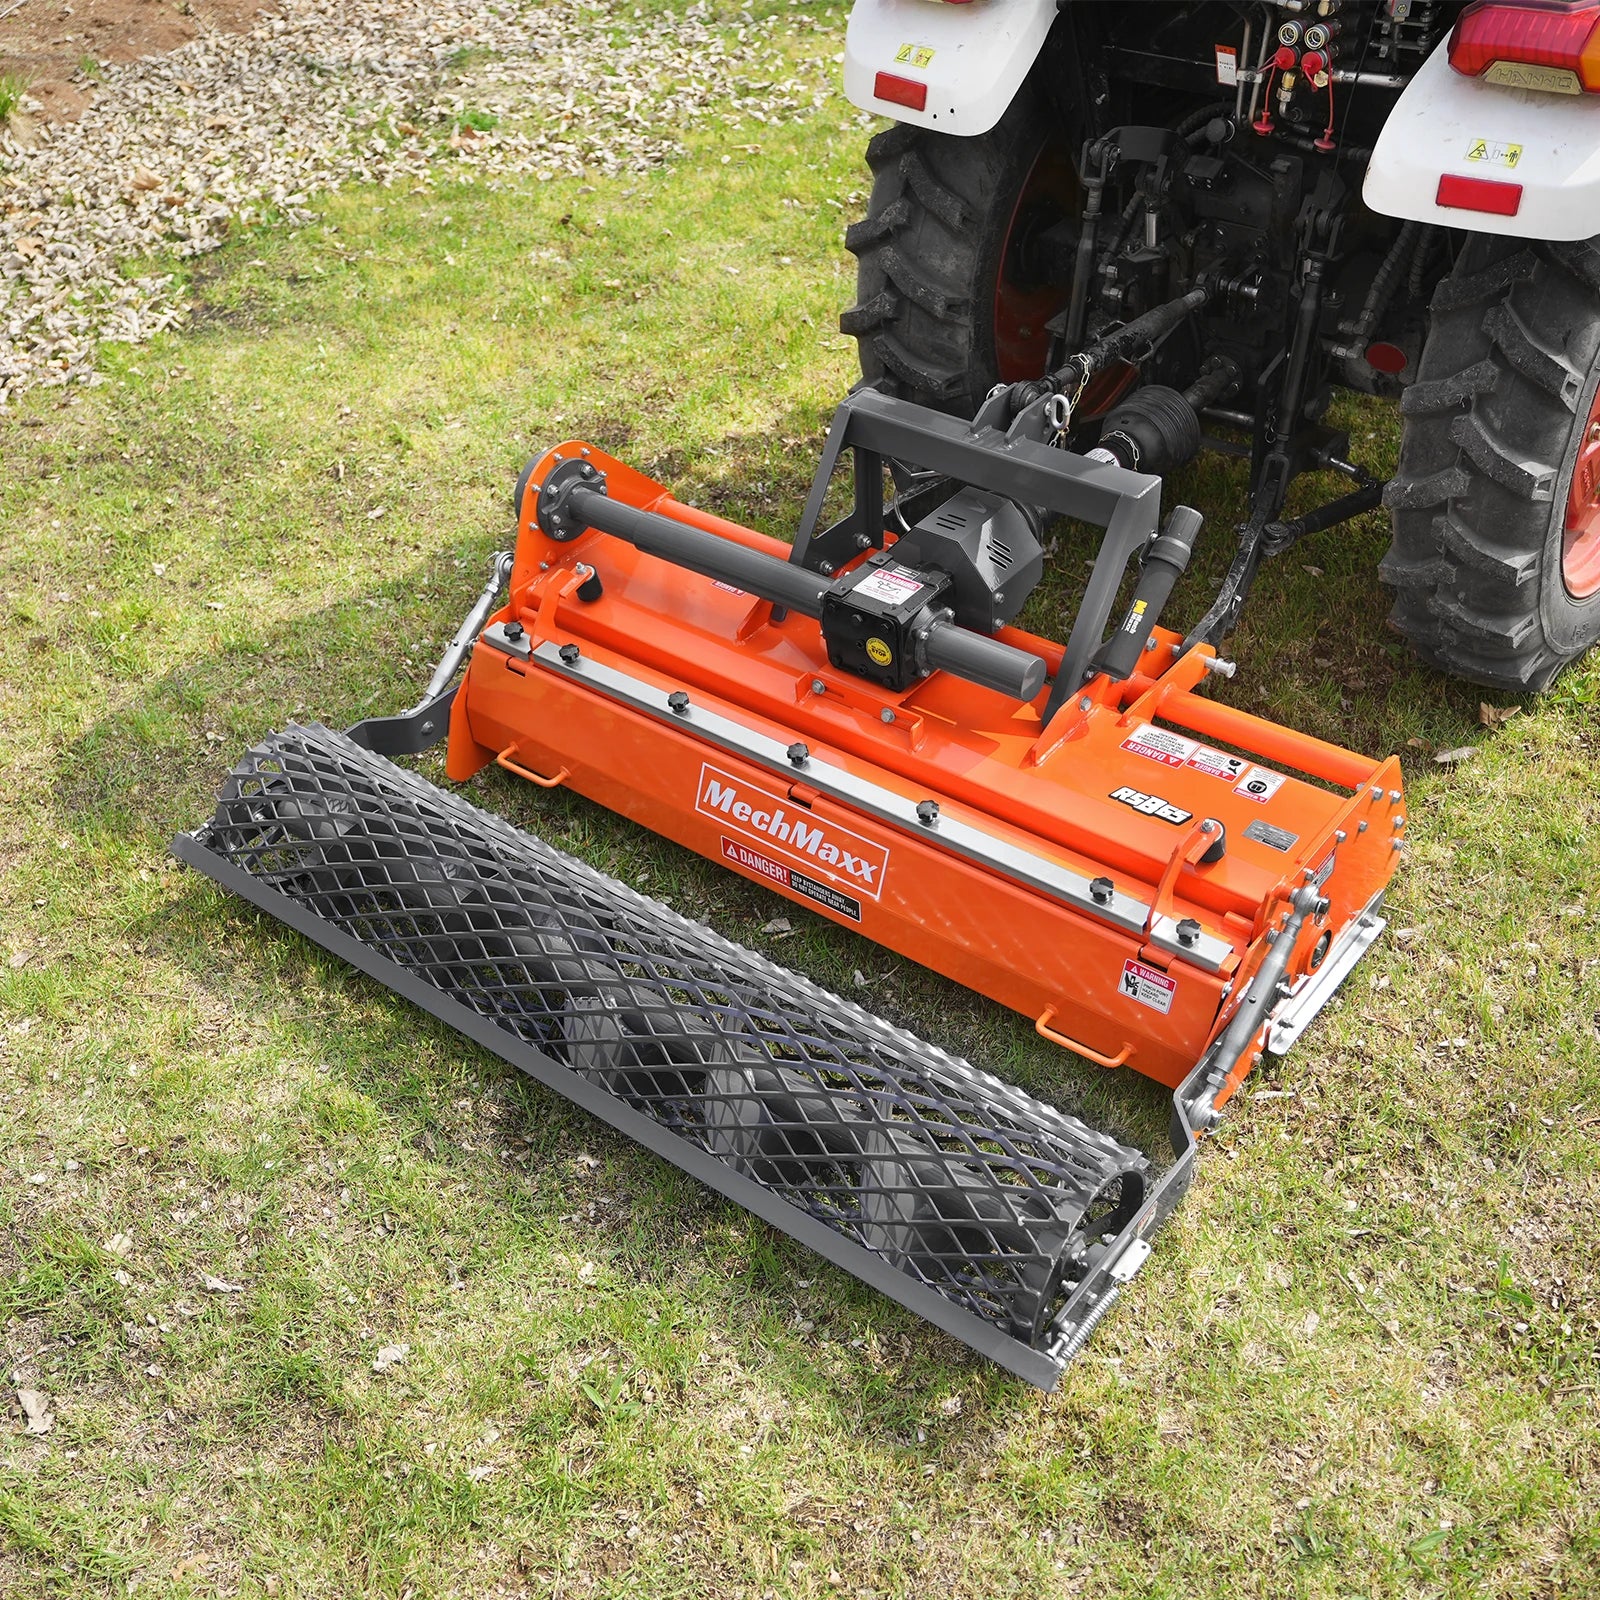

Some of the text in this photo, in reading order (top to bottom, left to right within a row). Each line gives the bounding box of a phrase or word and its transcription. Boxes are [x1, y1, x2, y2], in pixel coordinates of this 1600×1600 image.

[883, 573, 917, 590] WARNING
[1129, 613, 1143, 634] Mech
[1126, 741, 1167, 761] DANGER
[1193, 762, 1221, 775] DANGER
[702, 779, 879, 884] MechMaxx
[739, 848, 788, 883] DANGER!
[802, 879, 831, 898] BYSTANDERS
[808, 888, 827, 902] OPERATE
[1139, 967, 1169, 988] WARNING
